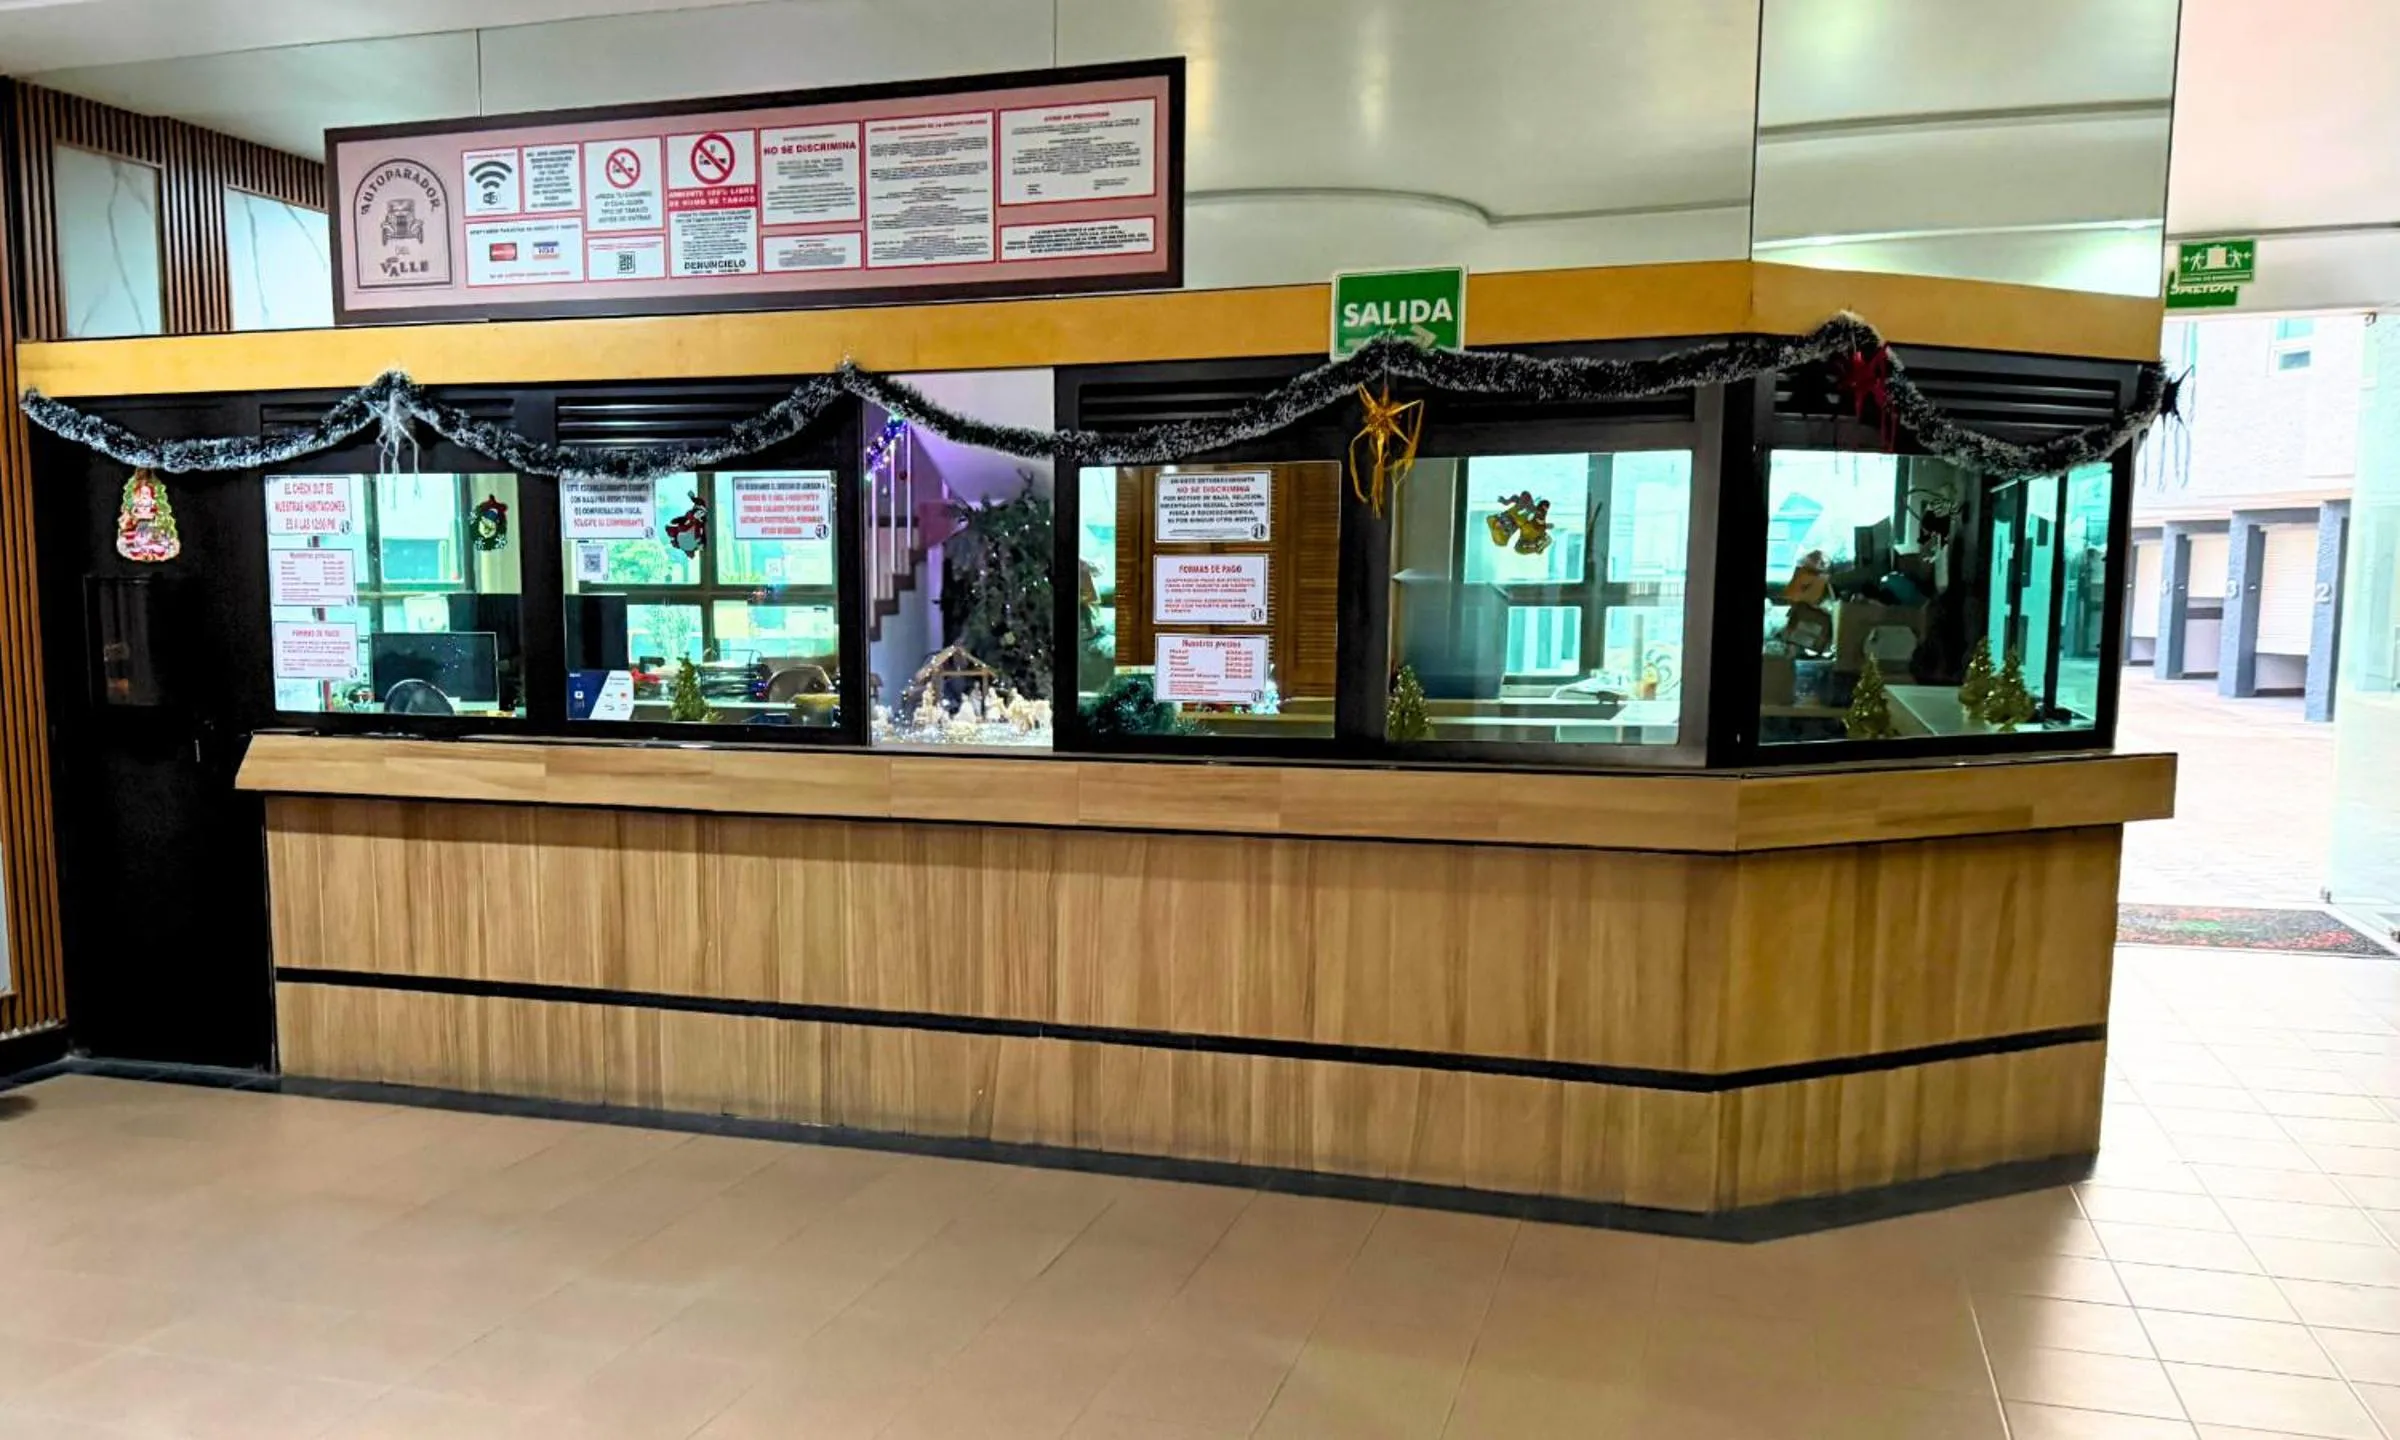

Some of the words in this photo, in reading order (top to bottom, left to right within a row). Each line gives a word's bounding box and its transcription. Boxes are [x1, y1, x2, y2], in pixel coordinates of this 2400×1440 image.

[763, 146, 778, 155] NO
[781, 145, 793, 154] SE
[796, 141, 857, 153] DISCRIMINA
[361, 168, 441, 215] AUTOPARADOR
[684, 259, 747, 270] DENUNCIELO
[1343, 297, 1453, 328] SALIDA
[1203, 485, 1250, 493] DISCRIMINA
[1179, 565, 1209, 573] FORMAS
[1211, 565, 1221, 573] DE
[1222, 565, 1242, 573] PAGO
[2226, 580, 2240, 599] 3
[2315, 583, 2334, 604] 2
